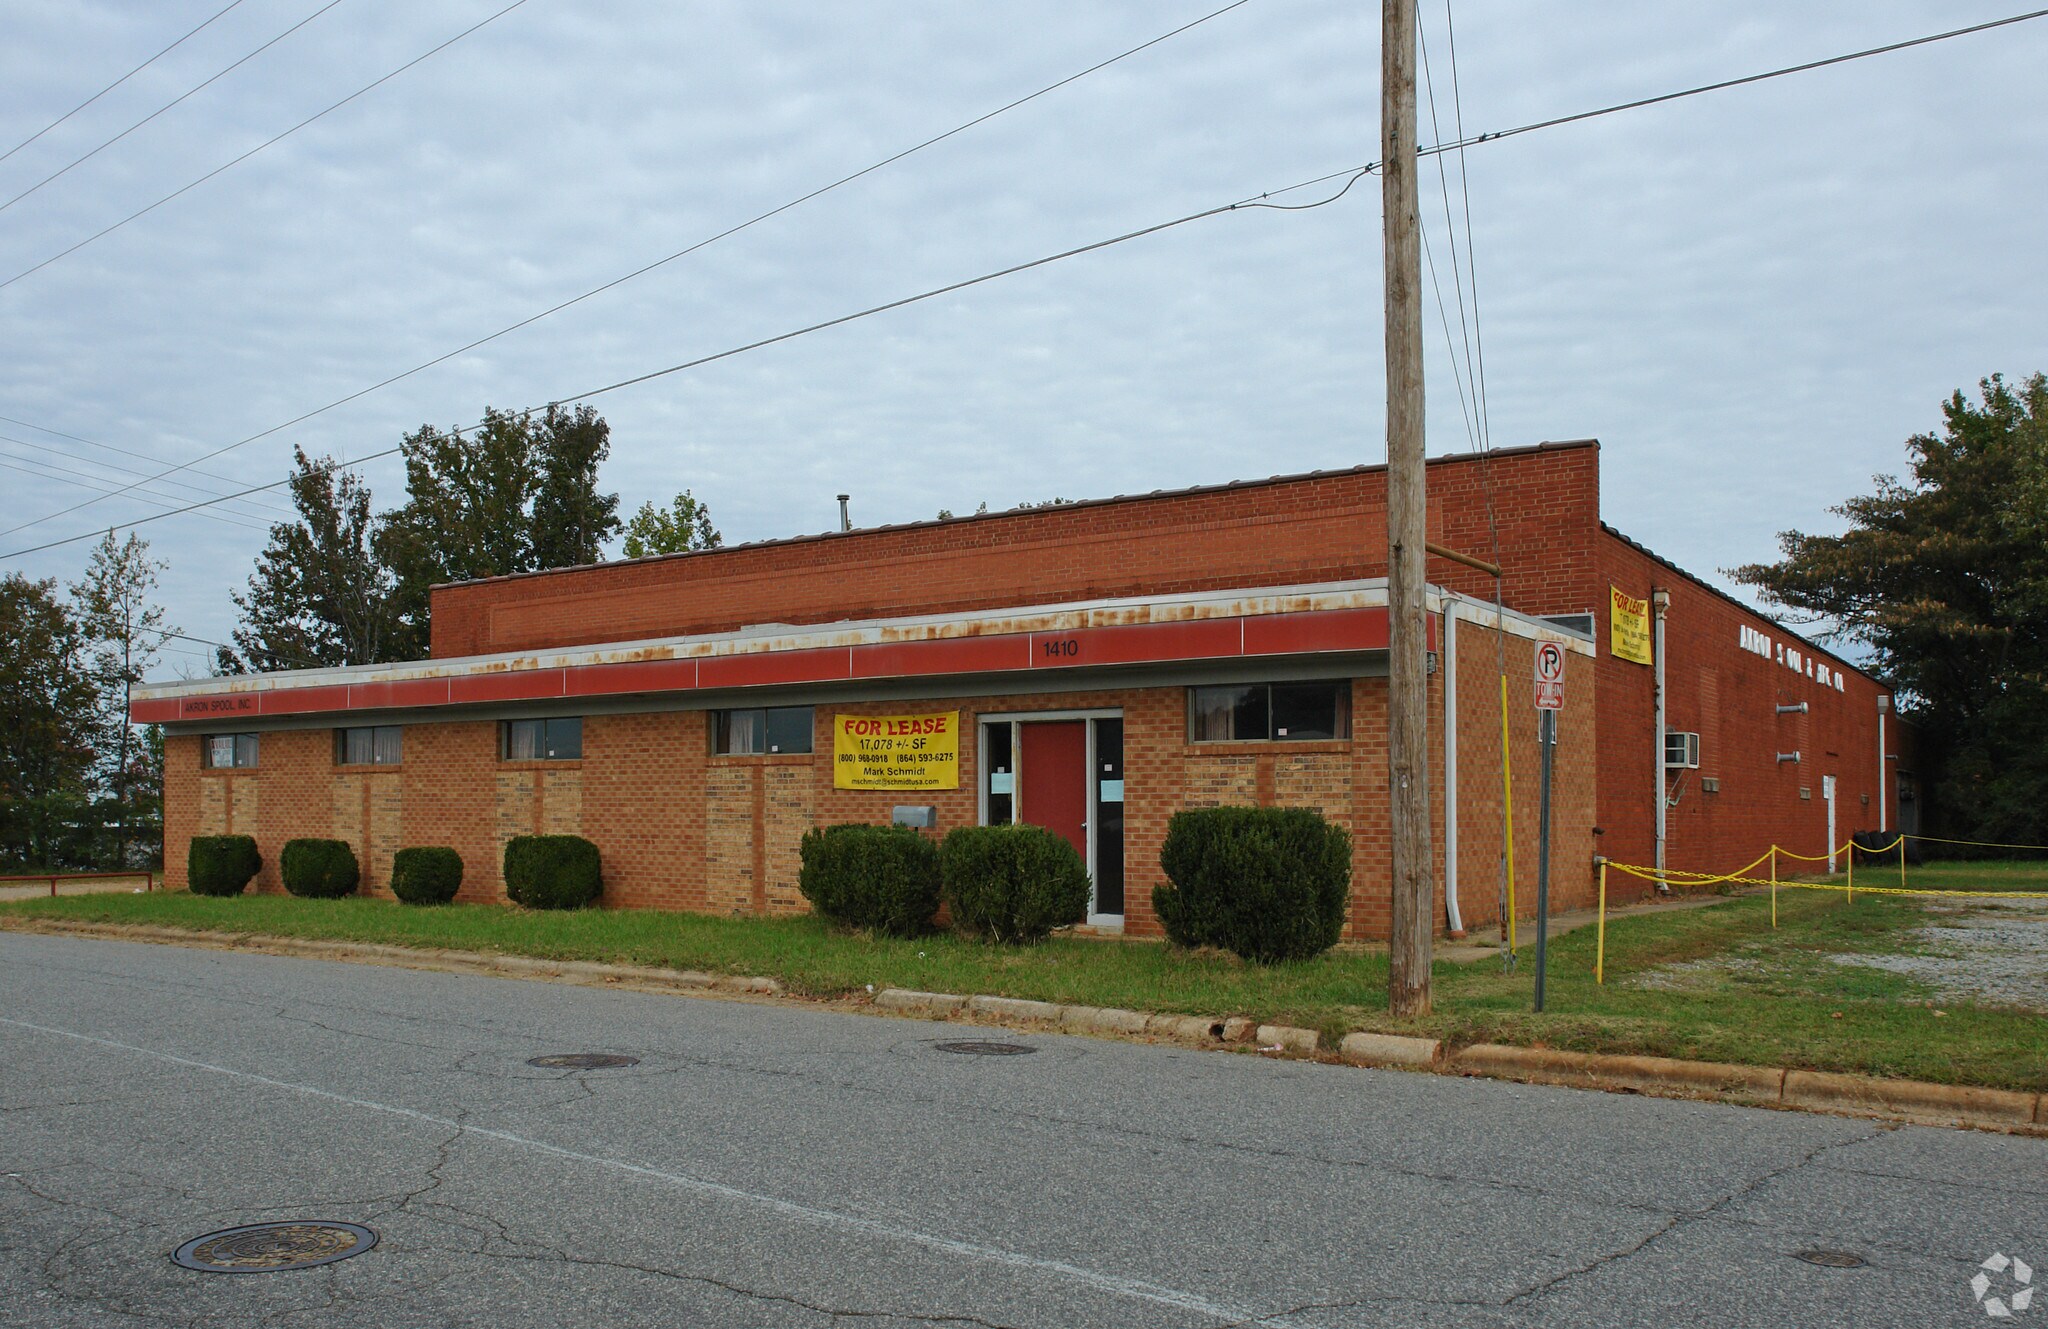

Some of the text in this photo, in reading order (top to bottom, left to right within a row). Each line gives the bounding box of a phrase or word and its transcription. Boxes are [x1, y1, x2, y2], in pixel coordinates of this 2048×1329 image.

[1043, 639, 1078, 657] 1410
[185, 702, 208, 712] AKRON
[844, 717, 947, 736] FOR LEASE
[860, 737, 927, 751] 17,078 +/- SF
[838, 753, 856, 764] (800)
[896, 752, 954, 764] (864) 593-6275
[863, 767, 926, 776] Mark Schmidt
